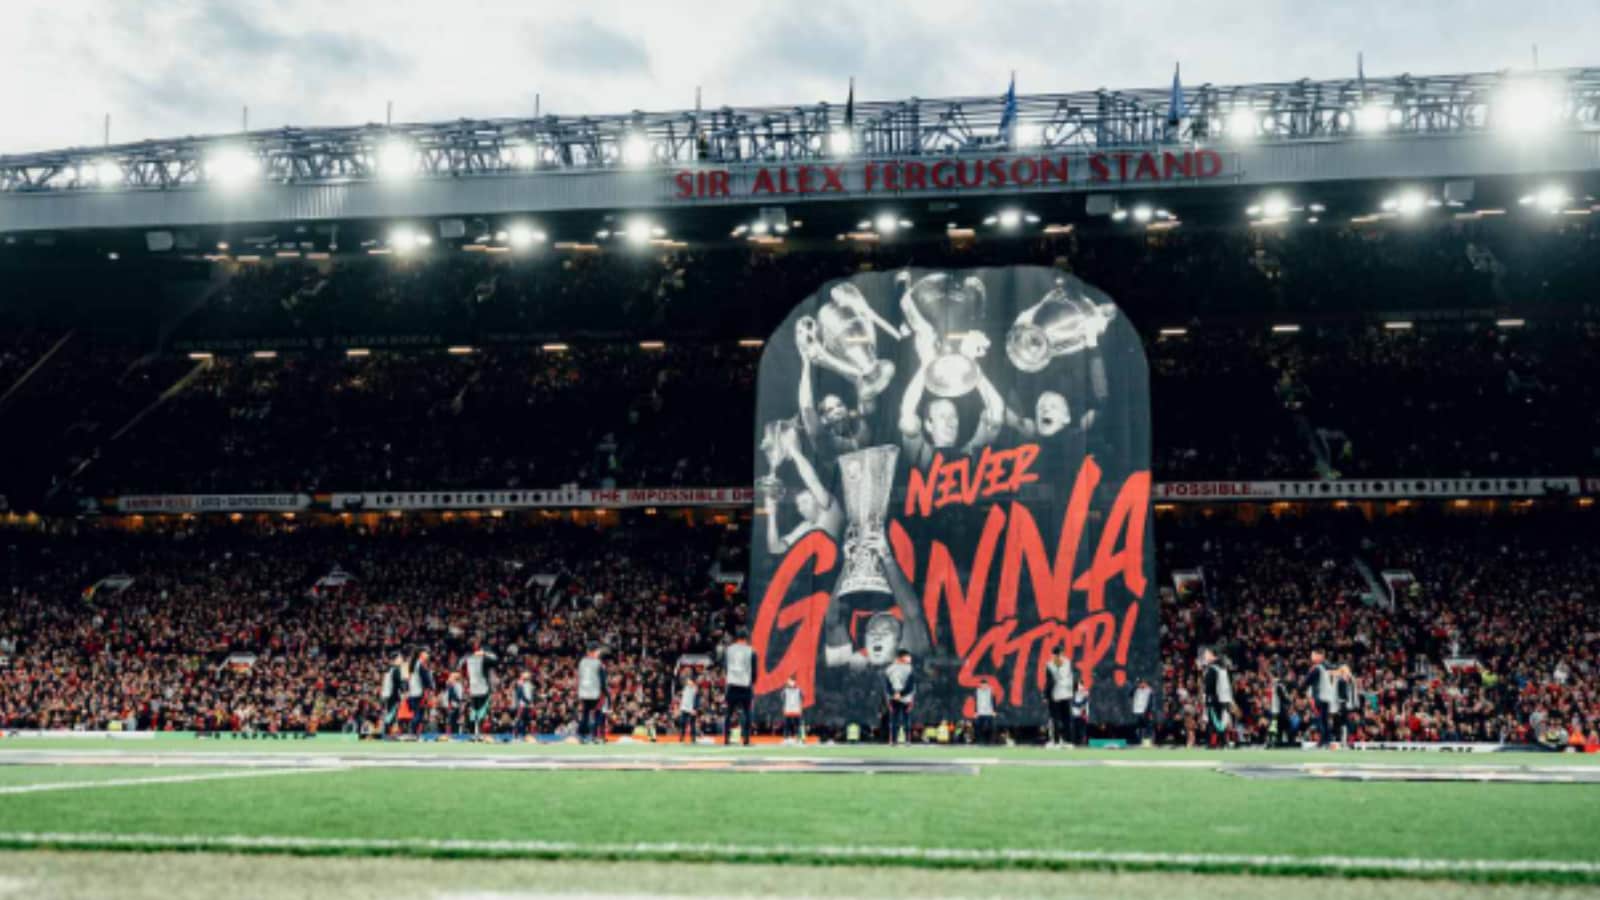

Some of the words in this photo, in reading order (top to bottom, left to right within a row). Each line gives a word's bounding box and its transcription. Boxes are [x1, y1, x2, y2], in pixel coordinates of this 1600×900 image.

[675, 169, 731, 198] SIR
[752, 164, 845, 194] ALEX
[864, 155, 1069, 192] FERGUSON
[1088, 149, 1223, 182] STAND
[592, 487, 622, 502] THE
[626, 486, 724, 502] IMPOSSIBLE
[905, 444, 1040, 518] NEVER
